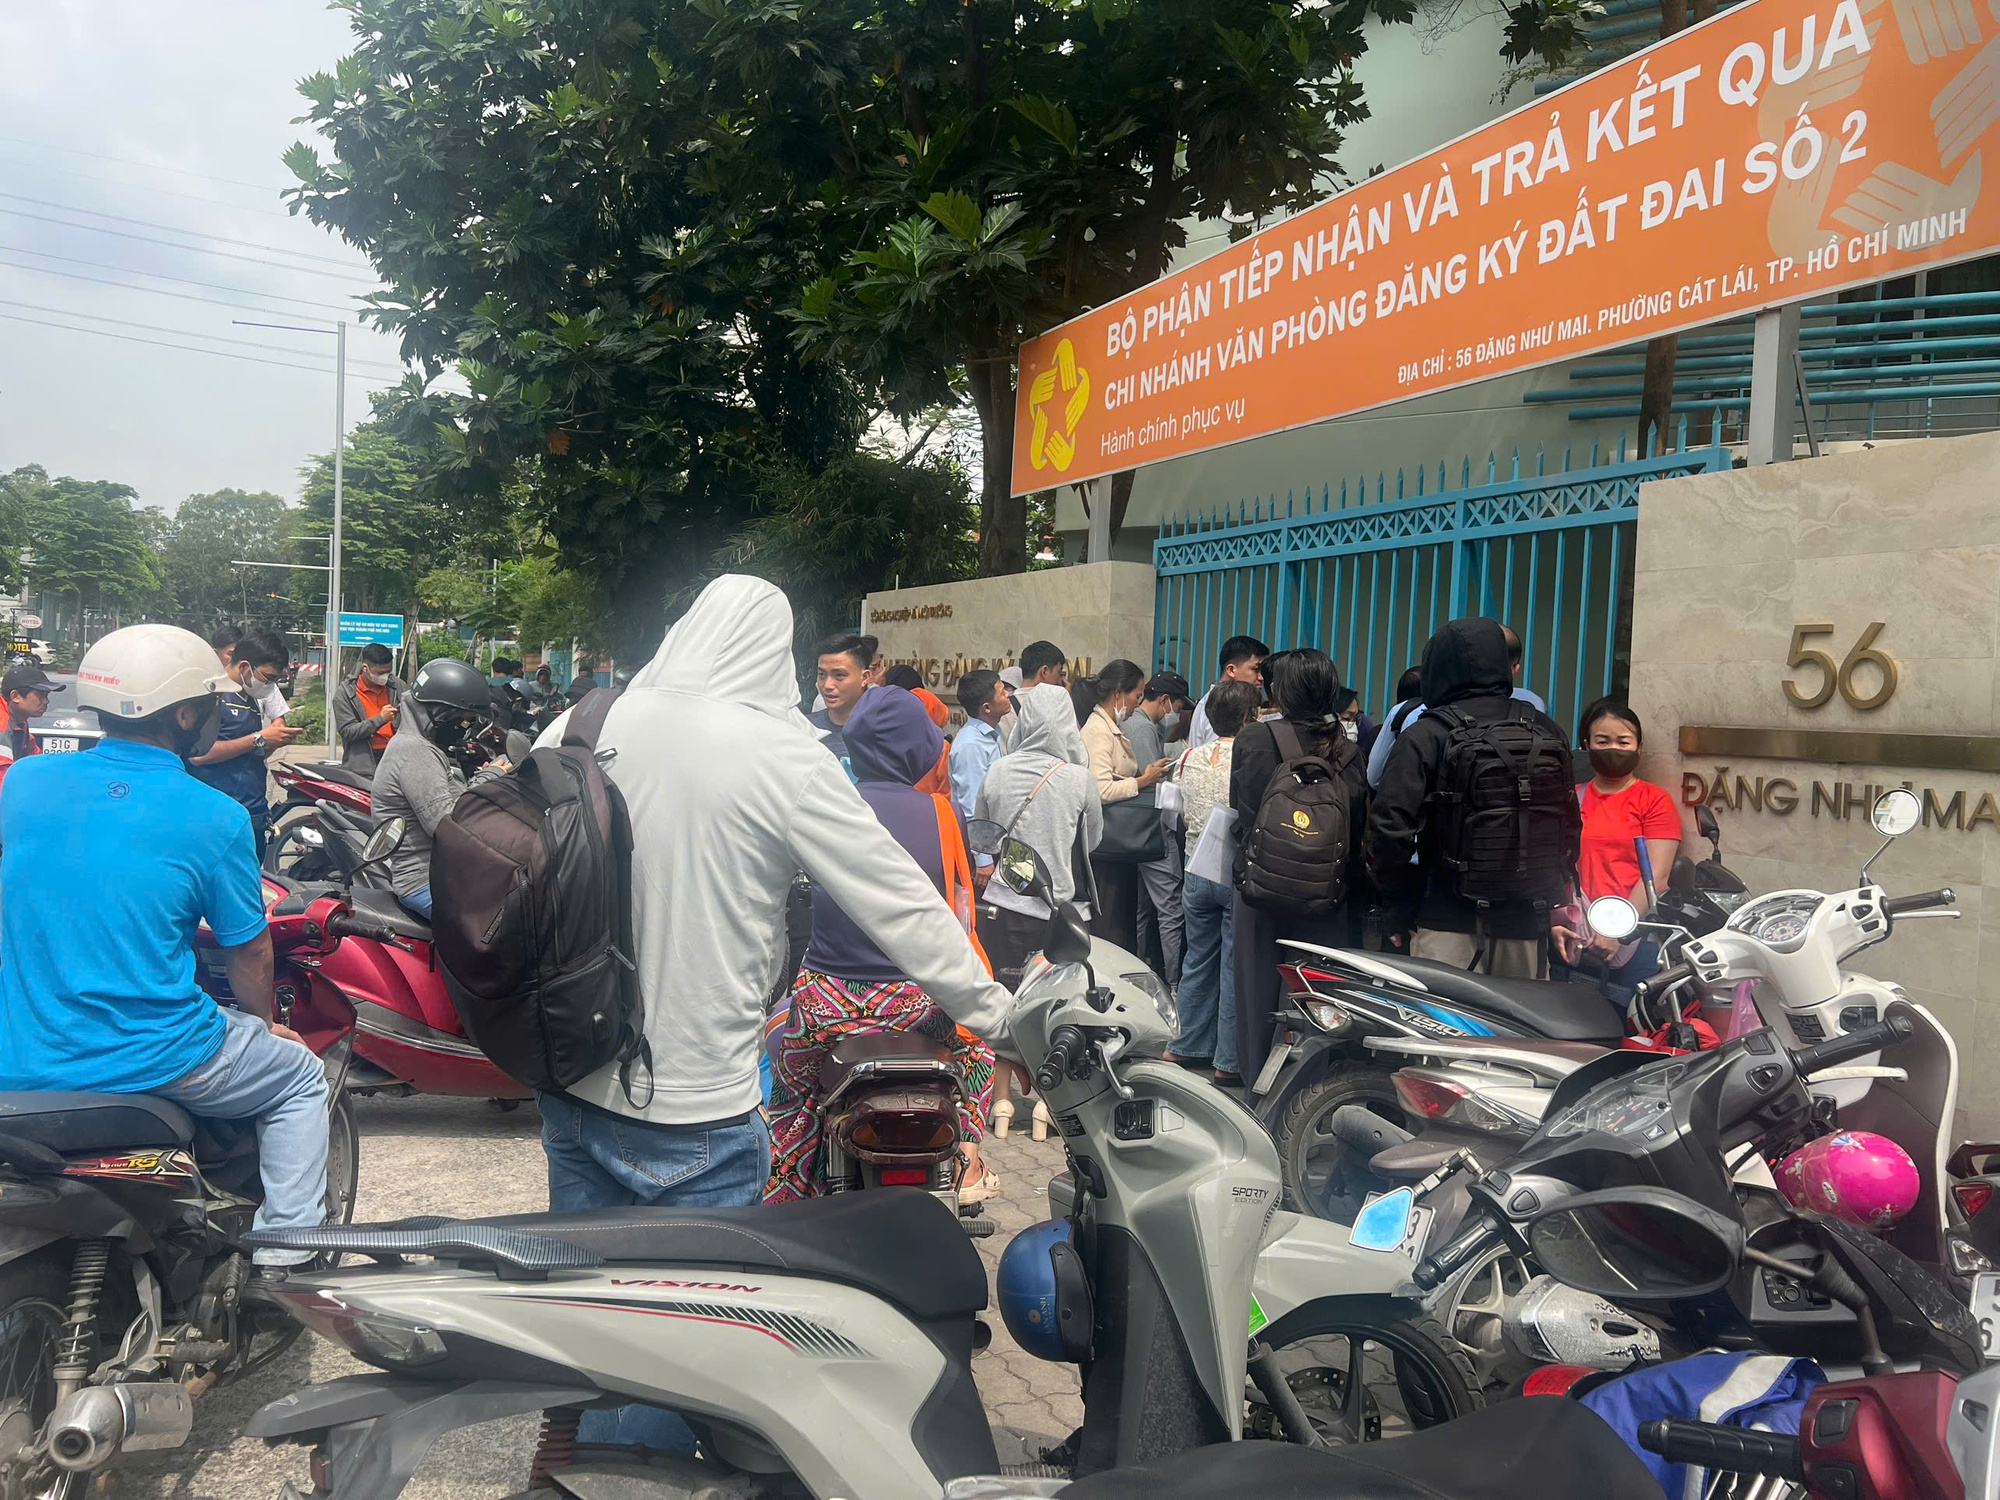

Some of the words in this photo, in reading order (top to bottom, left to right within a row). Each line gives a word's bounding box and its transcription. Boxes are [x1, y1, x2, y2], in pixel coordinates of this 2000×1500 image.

[1107, 306, 1137, 360] BỘ
[1142, 280, 1211, 343] PHẬN
[1219, 239, 1283, 309] TIẾP
[1292, 200, 1391, 282] NHẬN
[1403, 160, 1459, 234] VÀ
[1471, 110, 1570, 206] TRẢ
[1587, 58, 1701, 163] KẾT
[1104, 375, 1135, 410] CHI
[1139, 346, 1211, 399] NHÁNH
[1216, 325, 1264, 372] VĂN
[1271, 290, 1367, 355] PHÒNG
[1375, 253, 1467, 319] ĐĂNG
[1478, 219, 1529, 285] KÝ
[1537, 186, 1628, 265] ĐẤT
[1639, 158, 1725, 231] ĐAI
[1742, 101, 1822, 194] SỐ
[1839, 110, 1867, 164] 2
[1397, 362, 1419, 386] ĐỊA
[1422, 349, 1445, 378] CHỈ
[1455, 347, 1472, 369] 56
[1475, 334, 1516, 364] ĐẶNG
[1520, 321, 1554, 352] NHƯ
[1597, 291, 1672, 331] PHƯỜNG
[1678, 276, 1717, 309] CÁT
[1721, 264, 1759, 298] LÁI,
[1766, 256, 1799, 285] TP.
[1807, 234, 1839, 274] HỒ
[1847, 222, 1890, 263] CHÍ
[1897, 207, 1967, 251] MINH
[1101, 427, 1135, 457] Hành
[1138, 413, 1177, 446] chính
[1181, 406, 1220, 440] phục
[1225, 397, 1245, 424] vụ
[1782, 622, 1897, 709] 56
[51, 739, 71, 750] 51G
[1681, 766, 1799, 815] ĐẶNG
[1232, 1186, 1269, 1199] SPORTY
[610, 1279, 762, 1293] VISION
